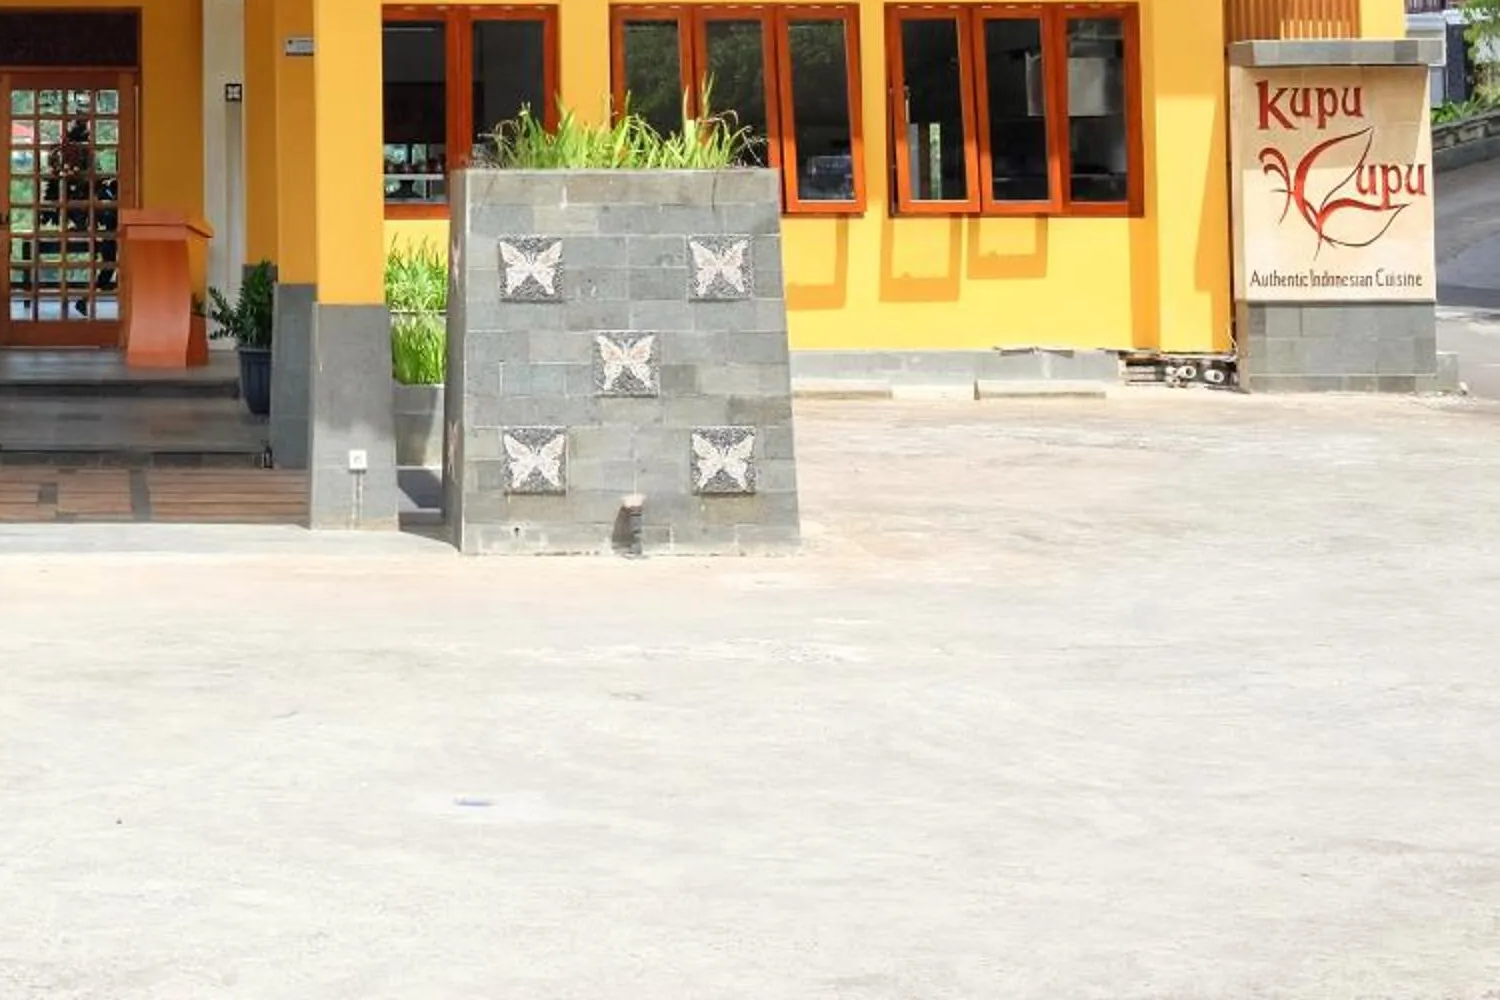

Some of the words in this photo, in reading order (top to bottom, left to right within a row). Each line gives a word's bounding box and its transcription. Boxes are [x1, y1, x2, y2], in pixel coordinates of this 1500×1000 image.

[1250, 270, 1308, 287] Authentic
[1309, 269, 1373, 288] Indonesian
[1375, 267, 1423, 287] Cuisine
